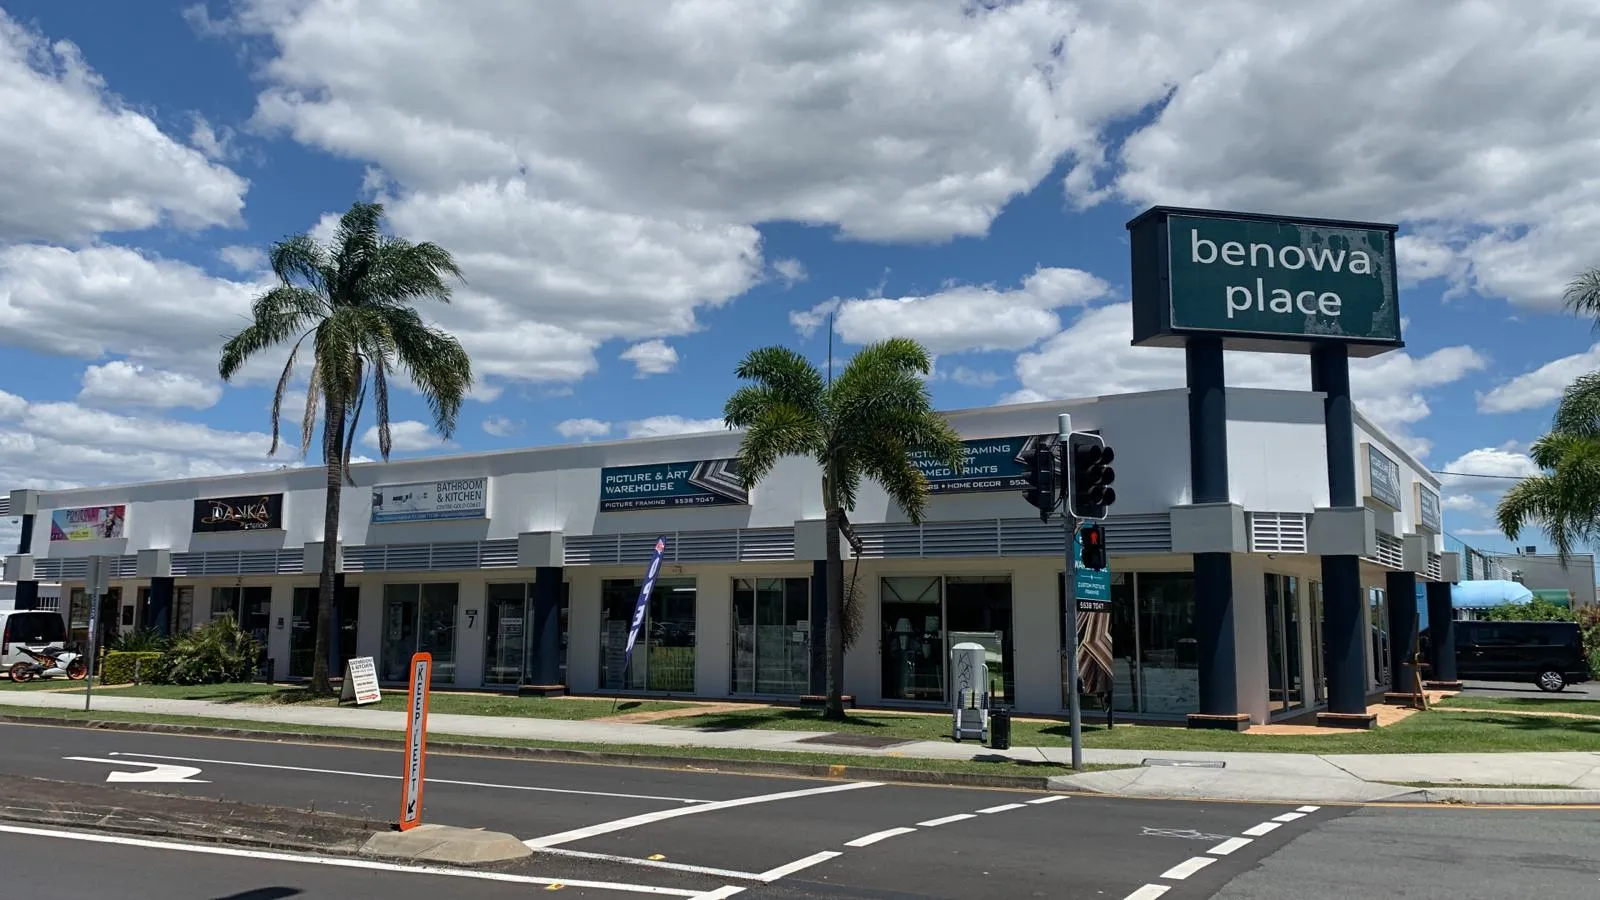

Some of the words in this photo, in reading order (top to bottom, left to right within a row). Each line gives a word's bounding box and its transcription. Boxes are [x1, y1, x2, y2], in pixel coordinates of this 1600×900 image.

[1191, 229, 1371, 275] benowa
[1226, 278, 1342, 319] place
[961, 444, 1011, 455] RAMING
[606, 472, 652, 484] PICTURE
[655, 472, 663, 480] &
[666, 470, 688, 480] ART
[973, 480, 1001, 488] DECOR
[437, 480, 483, 492] BATHROOM
[605, 482, 675, 494] WAREHOUSE
[437, 493, 444, 503] &
[445, 490, 481, 502] KITCHEN
[210, 501, 270, 521] DANKA
[468, 615, 475, 629] 7
[414, 667, 424, 724] KEEP
[411, 731, 419, 791] LEFT
